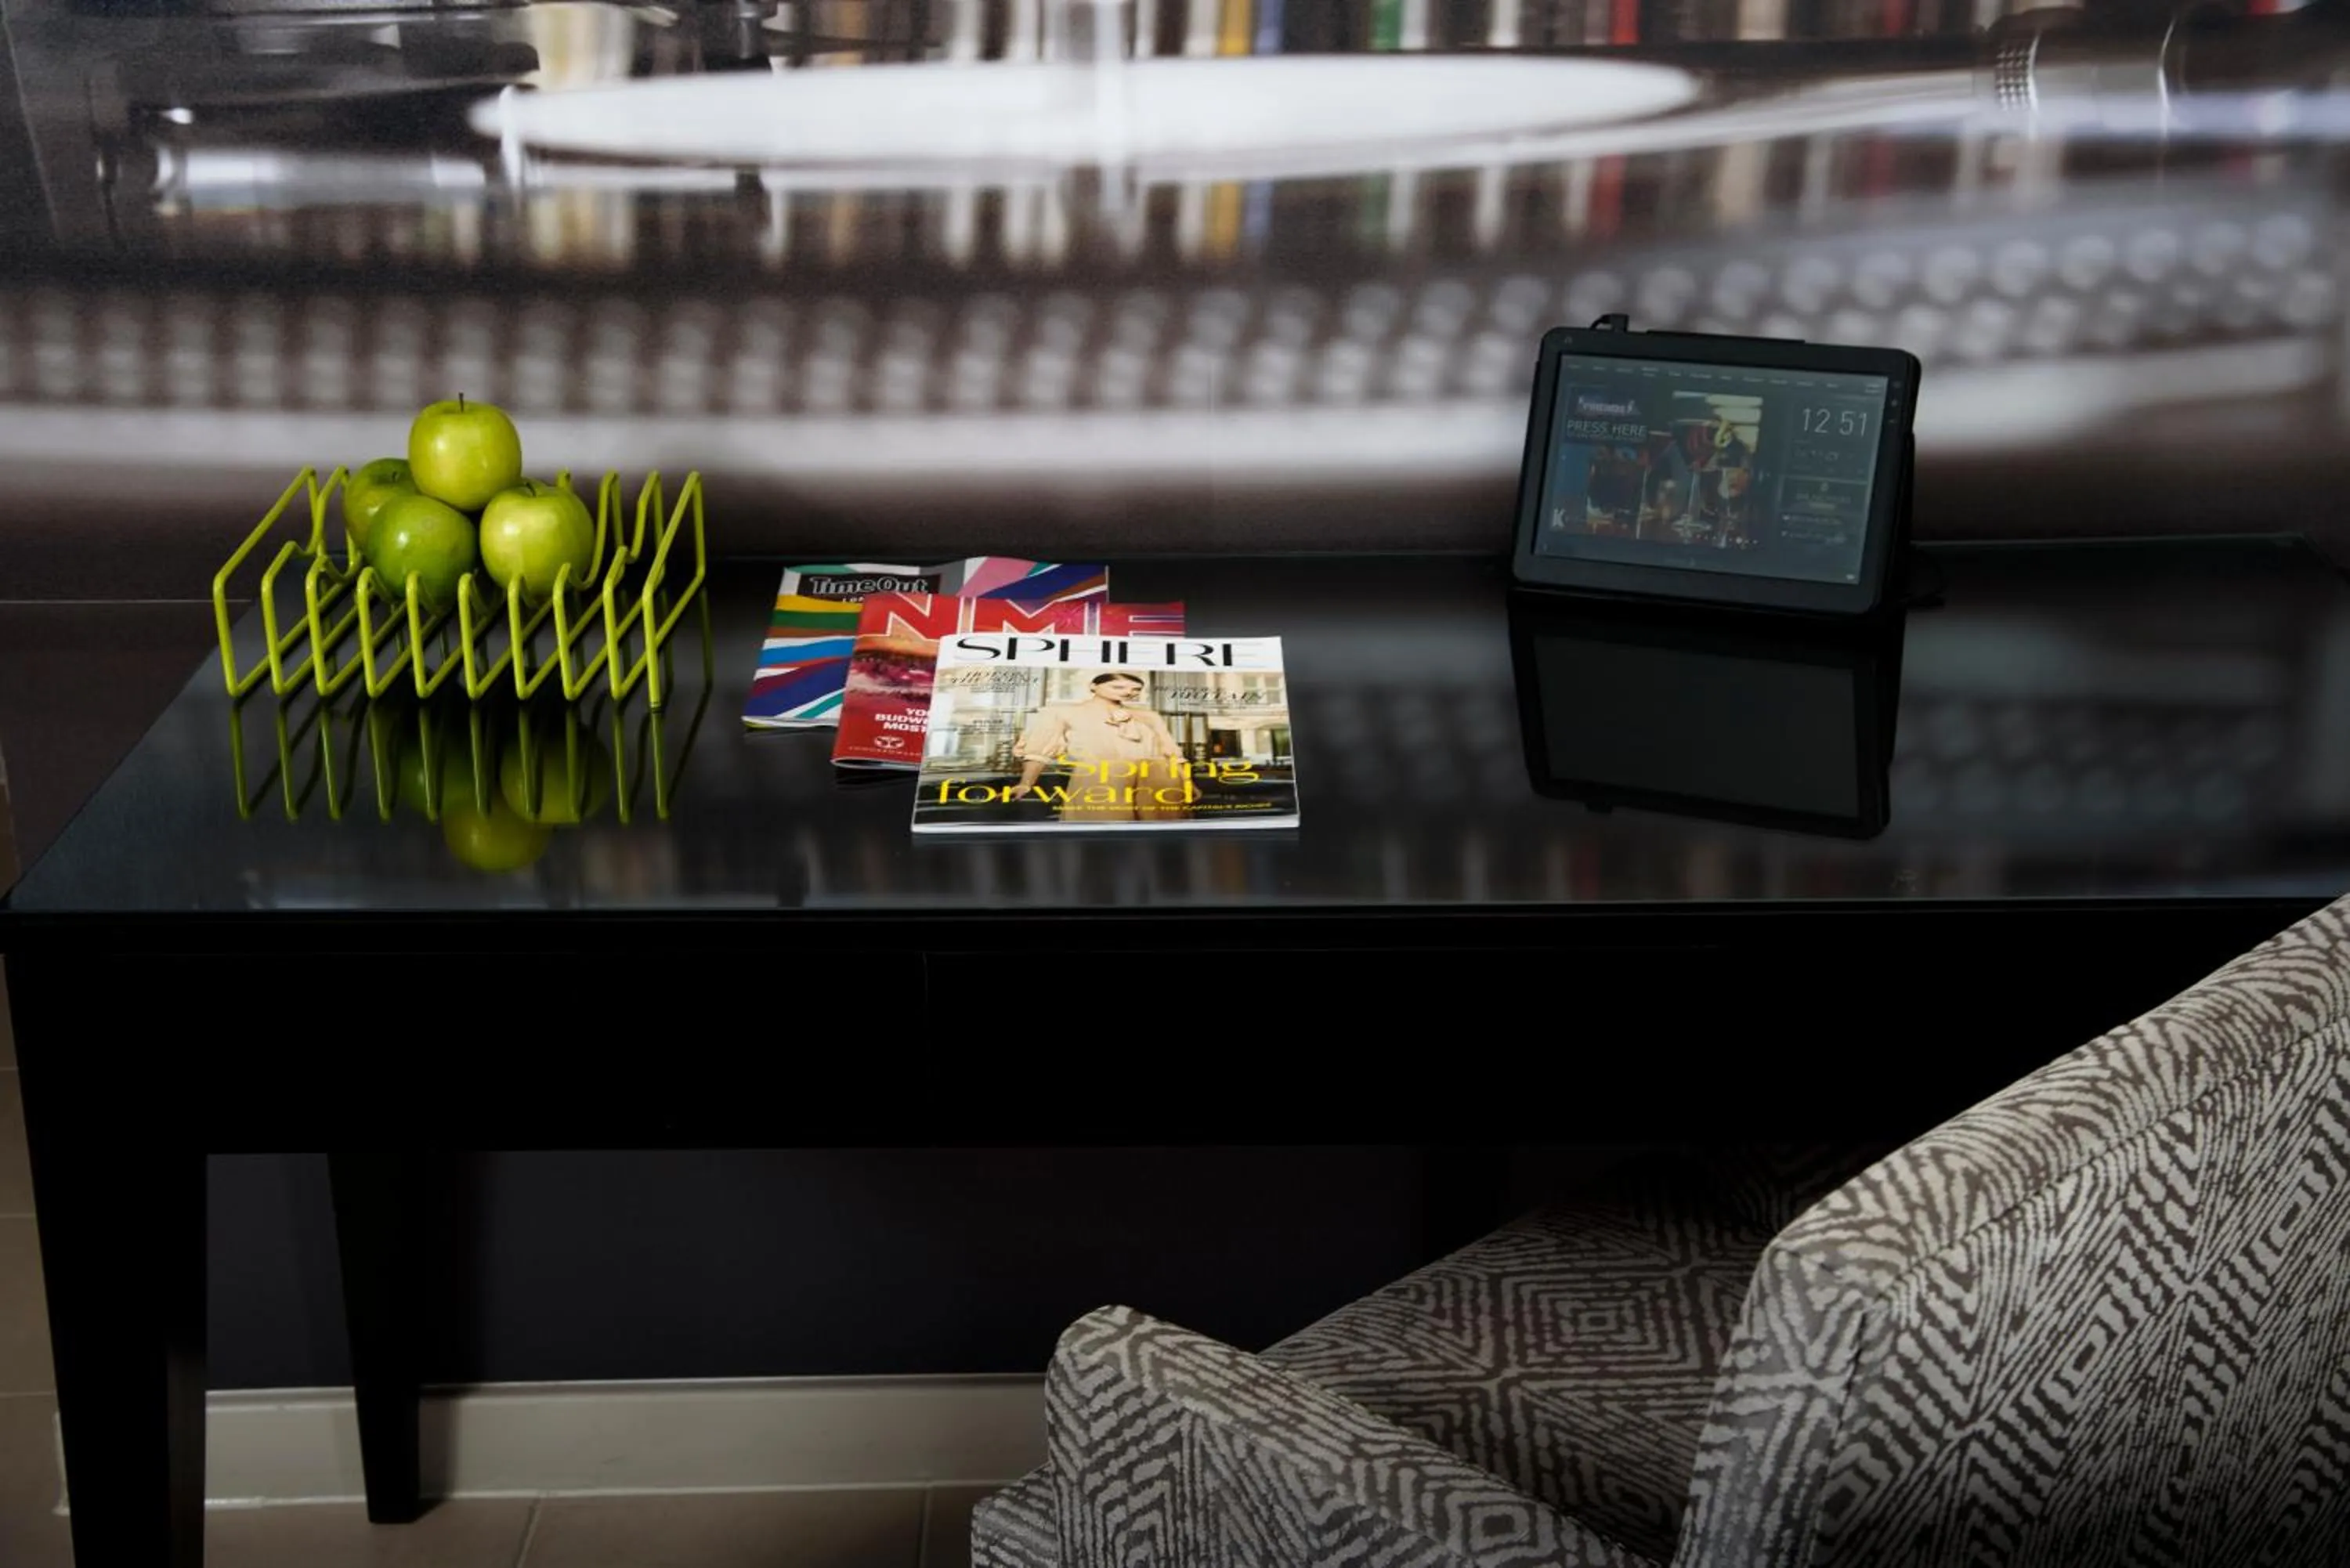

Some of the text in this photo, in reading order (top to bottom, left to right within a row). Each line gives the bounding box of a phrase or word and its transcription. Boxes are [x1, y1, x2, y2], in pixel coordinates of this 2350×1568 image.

[1567, 419, 1648, 437] PRESS HERE
[859, 592, 1185, 638] NME
[955, 636, 1268, 668] SPHERE
[906, 707, 930, 717] YO
[1054, 752, 1260, 784] Spring
[938, 777, 1195, 804] forward
